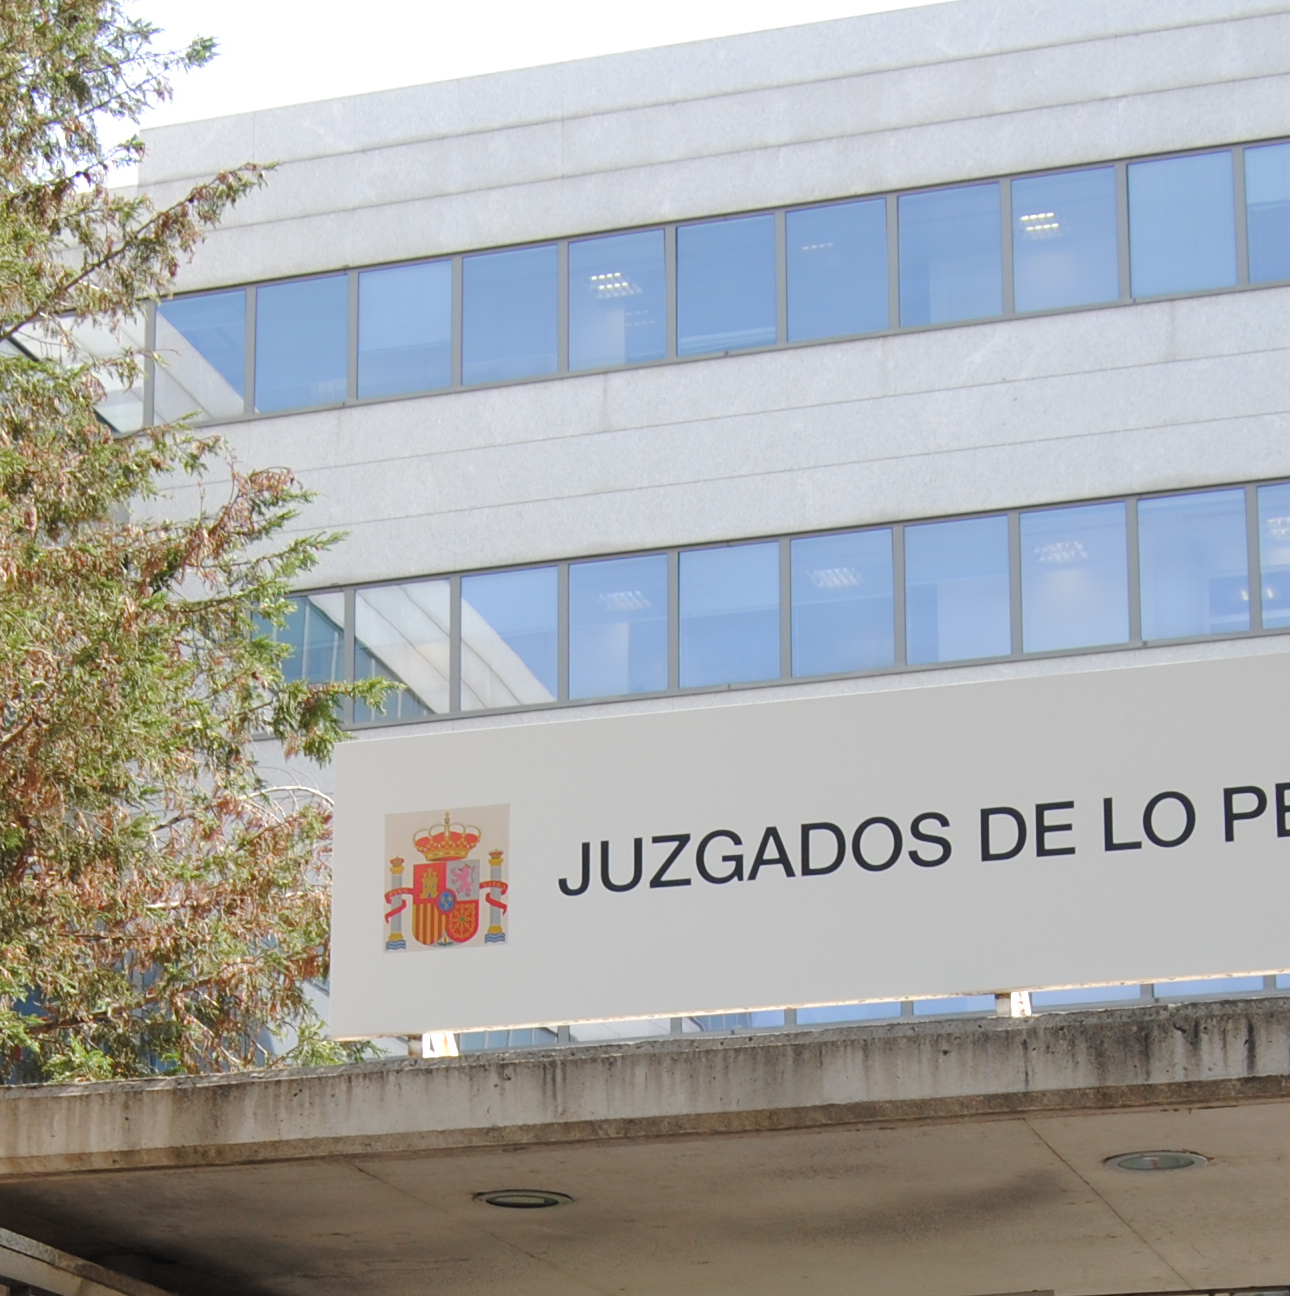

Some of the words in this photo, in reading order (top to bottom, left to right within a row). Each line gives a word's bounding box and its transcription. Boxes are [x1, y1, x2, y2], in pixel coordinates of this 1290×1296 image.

[558, 811, 952, 898] JUZGADOS
[980, 800, 1076, 862] DE
[1103, 790, 1196, 853] LO
